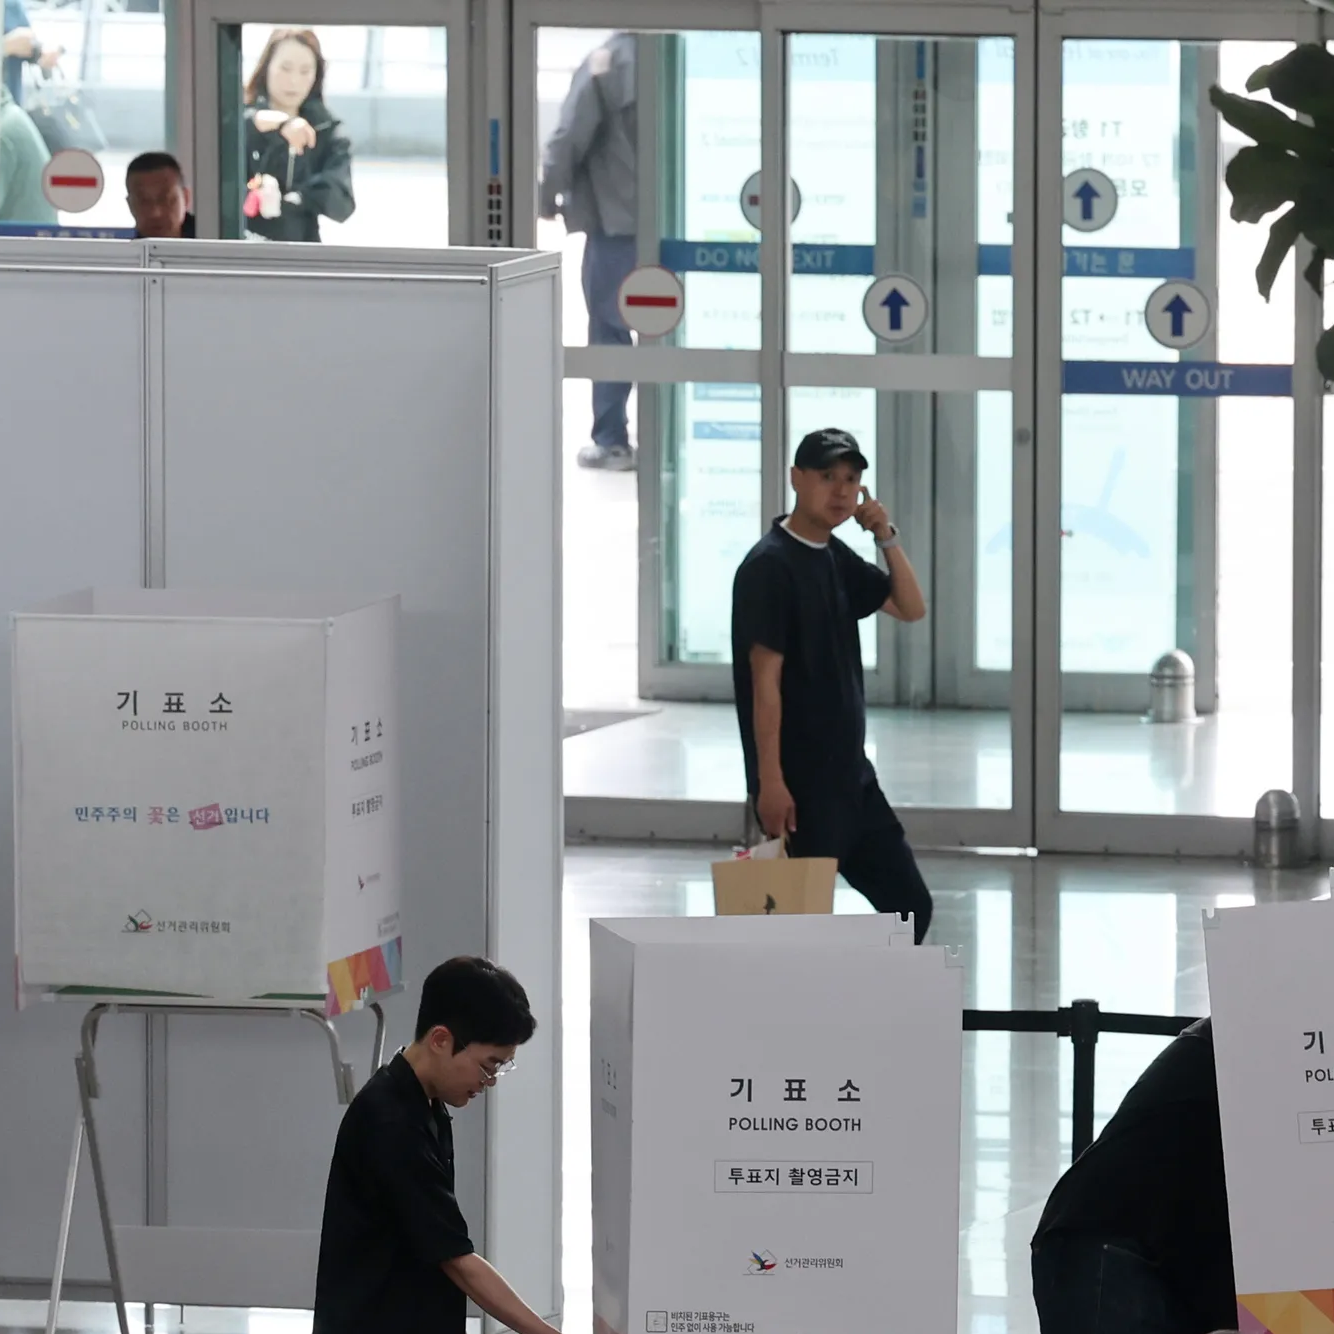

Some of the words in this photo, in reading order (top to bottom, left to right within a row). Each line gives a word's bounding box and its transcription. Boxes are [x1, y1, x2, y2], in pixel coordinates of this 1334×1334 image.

[736, 248, 759, 267] NO
[1121, 368, 1176, 389] WAY
[1186, 368, 1234, 390] OUT
[122, 721, 176, 731] POLLING
[183, 721, 228, 731] BOOTH
[75, 806, 137, 823] 민주주의
[148, 806, 180, 824] 꽃은
[729, 1117, 798, 1131] POLLING
[805, 1118, 861, 1131] BOOTH
[728, 1168, 779, 1185] 투표지
[788, 1167, 858, 1186] 촬영금지
[671, 1311, 693, 1321] 비치된
